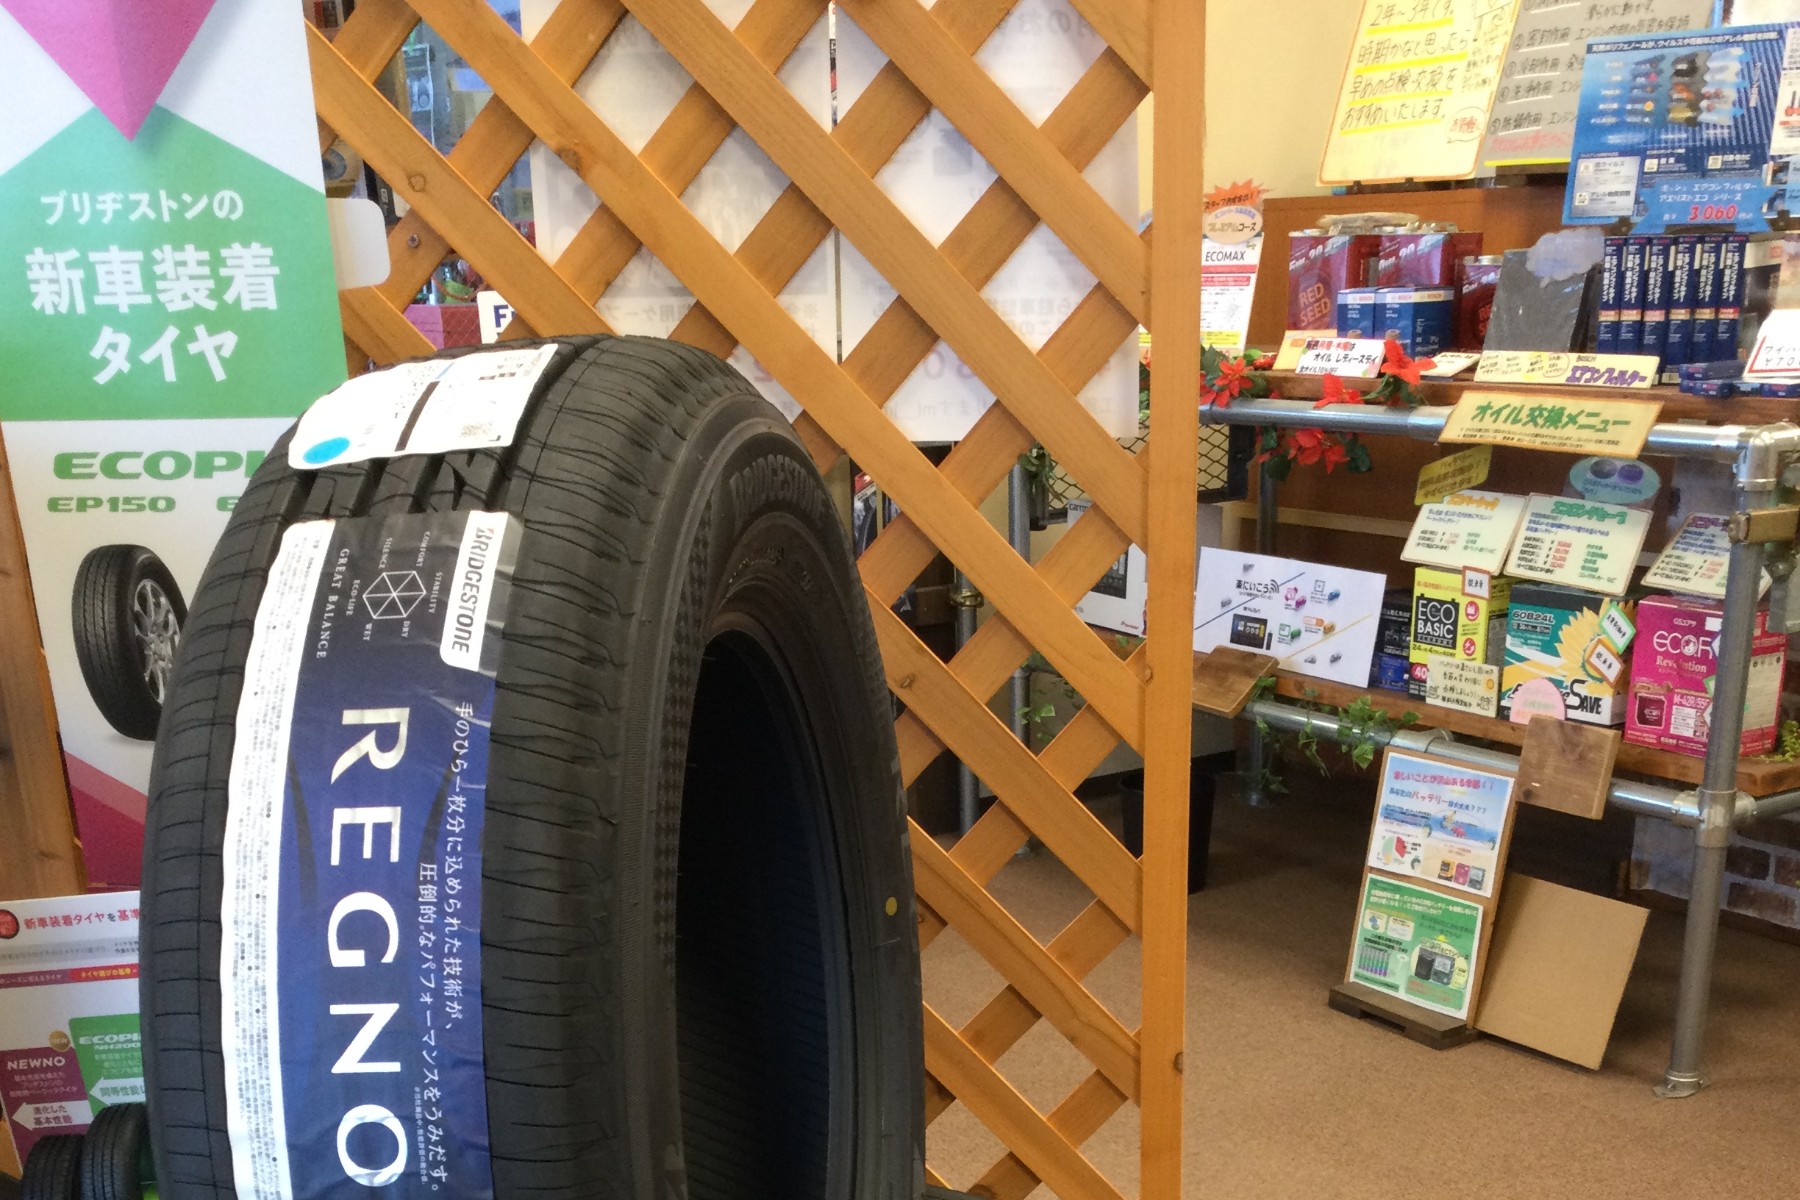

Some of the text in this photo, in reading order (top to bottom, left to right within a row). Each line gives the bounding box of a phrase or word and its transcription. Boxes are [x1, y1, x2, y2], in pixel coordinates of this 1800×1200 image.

[41, 189, 244, 226] ブリヂストンの
[1205, 251, 1246, 262] ECOMAX
[24, 241, 281, 315] 新車装着
[90, 324, 239, 385] タイヤ
[1565, 365, 1648, 386] エアコンフィルター
[1470, 400, 1631, 434] オイル交換メニュー
[47, 496, 177, 513] EP150
[415, 531, 432, 567] COMFORT
[315, 548, 350, 660] GREAT BALANCE
[428, 571, 443, 614] STABILITY
[451, 526, 495, 655] BRIDGESTONE
[1417, 600, 1456, 624] ECO
[1512, 609, 1555, 624] 60B24L
[1417, 620, 1454, 639] BASIC
[443, 701, 474, 1030] 手のひら一枚分に込められた技術が、
[328, 706, 411, 1188] REGNO
[7, 1056, 66, 1071] NEWNO
[33, 1104, 68, 1115] 進化した
[33, 1115, 74, 1126] 基本性能
